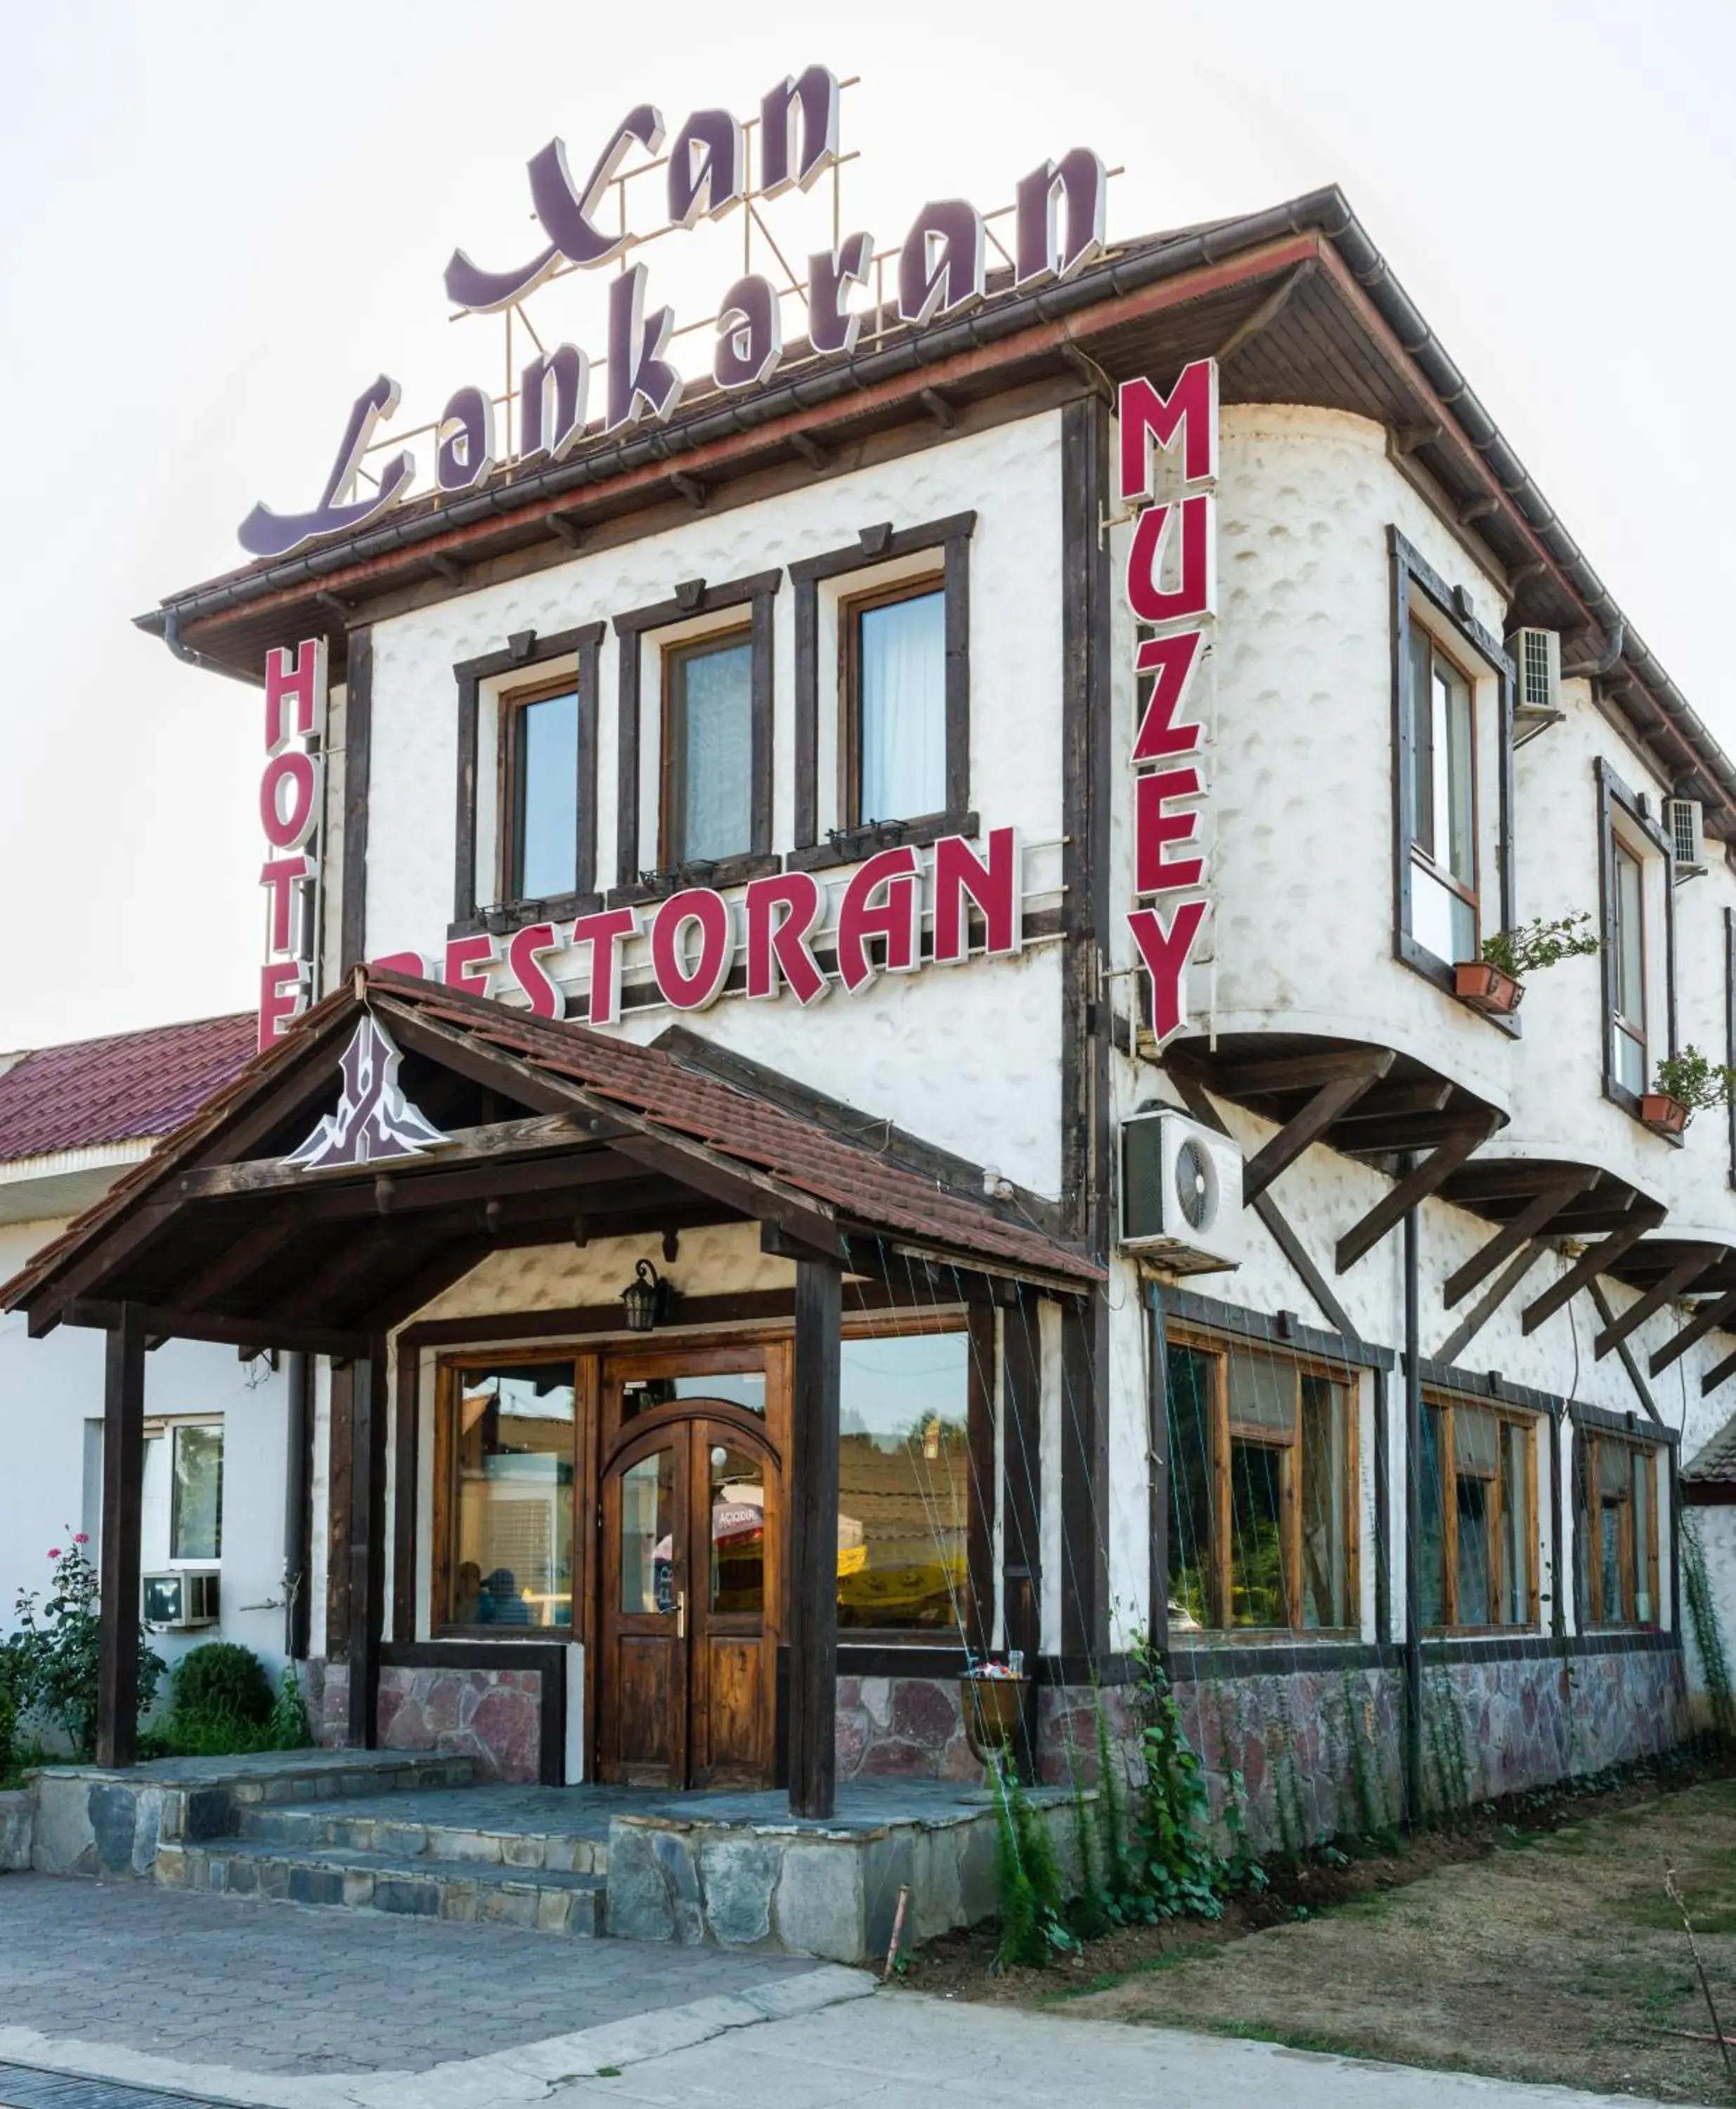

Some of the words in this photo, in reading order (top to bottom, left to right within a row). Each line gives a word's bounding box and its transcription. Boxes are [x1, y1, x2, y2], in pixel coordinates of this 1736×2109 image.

[443, 63, 840, 314] Xan
[1118, 357, 1218, 1047] MUZEY
[371, 826, 1021, 1026] ESTORAN
